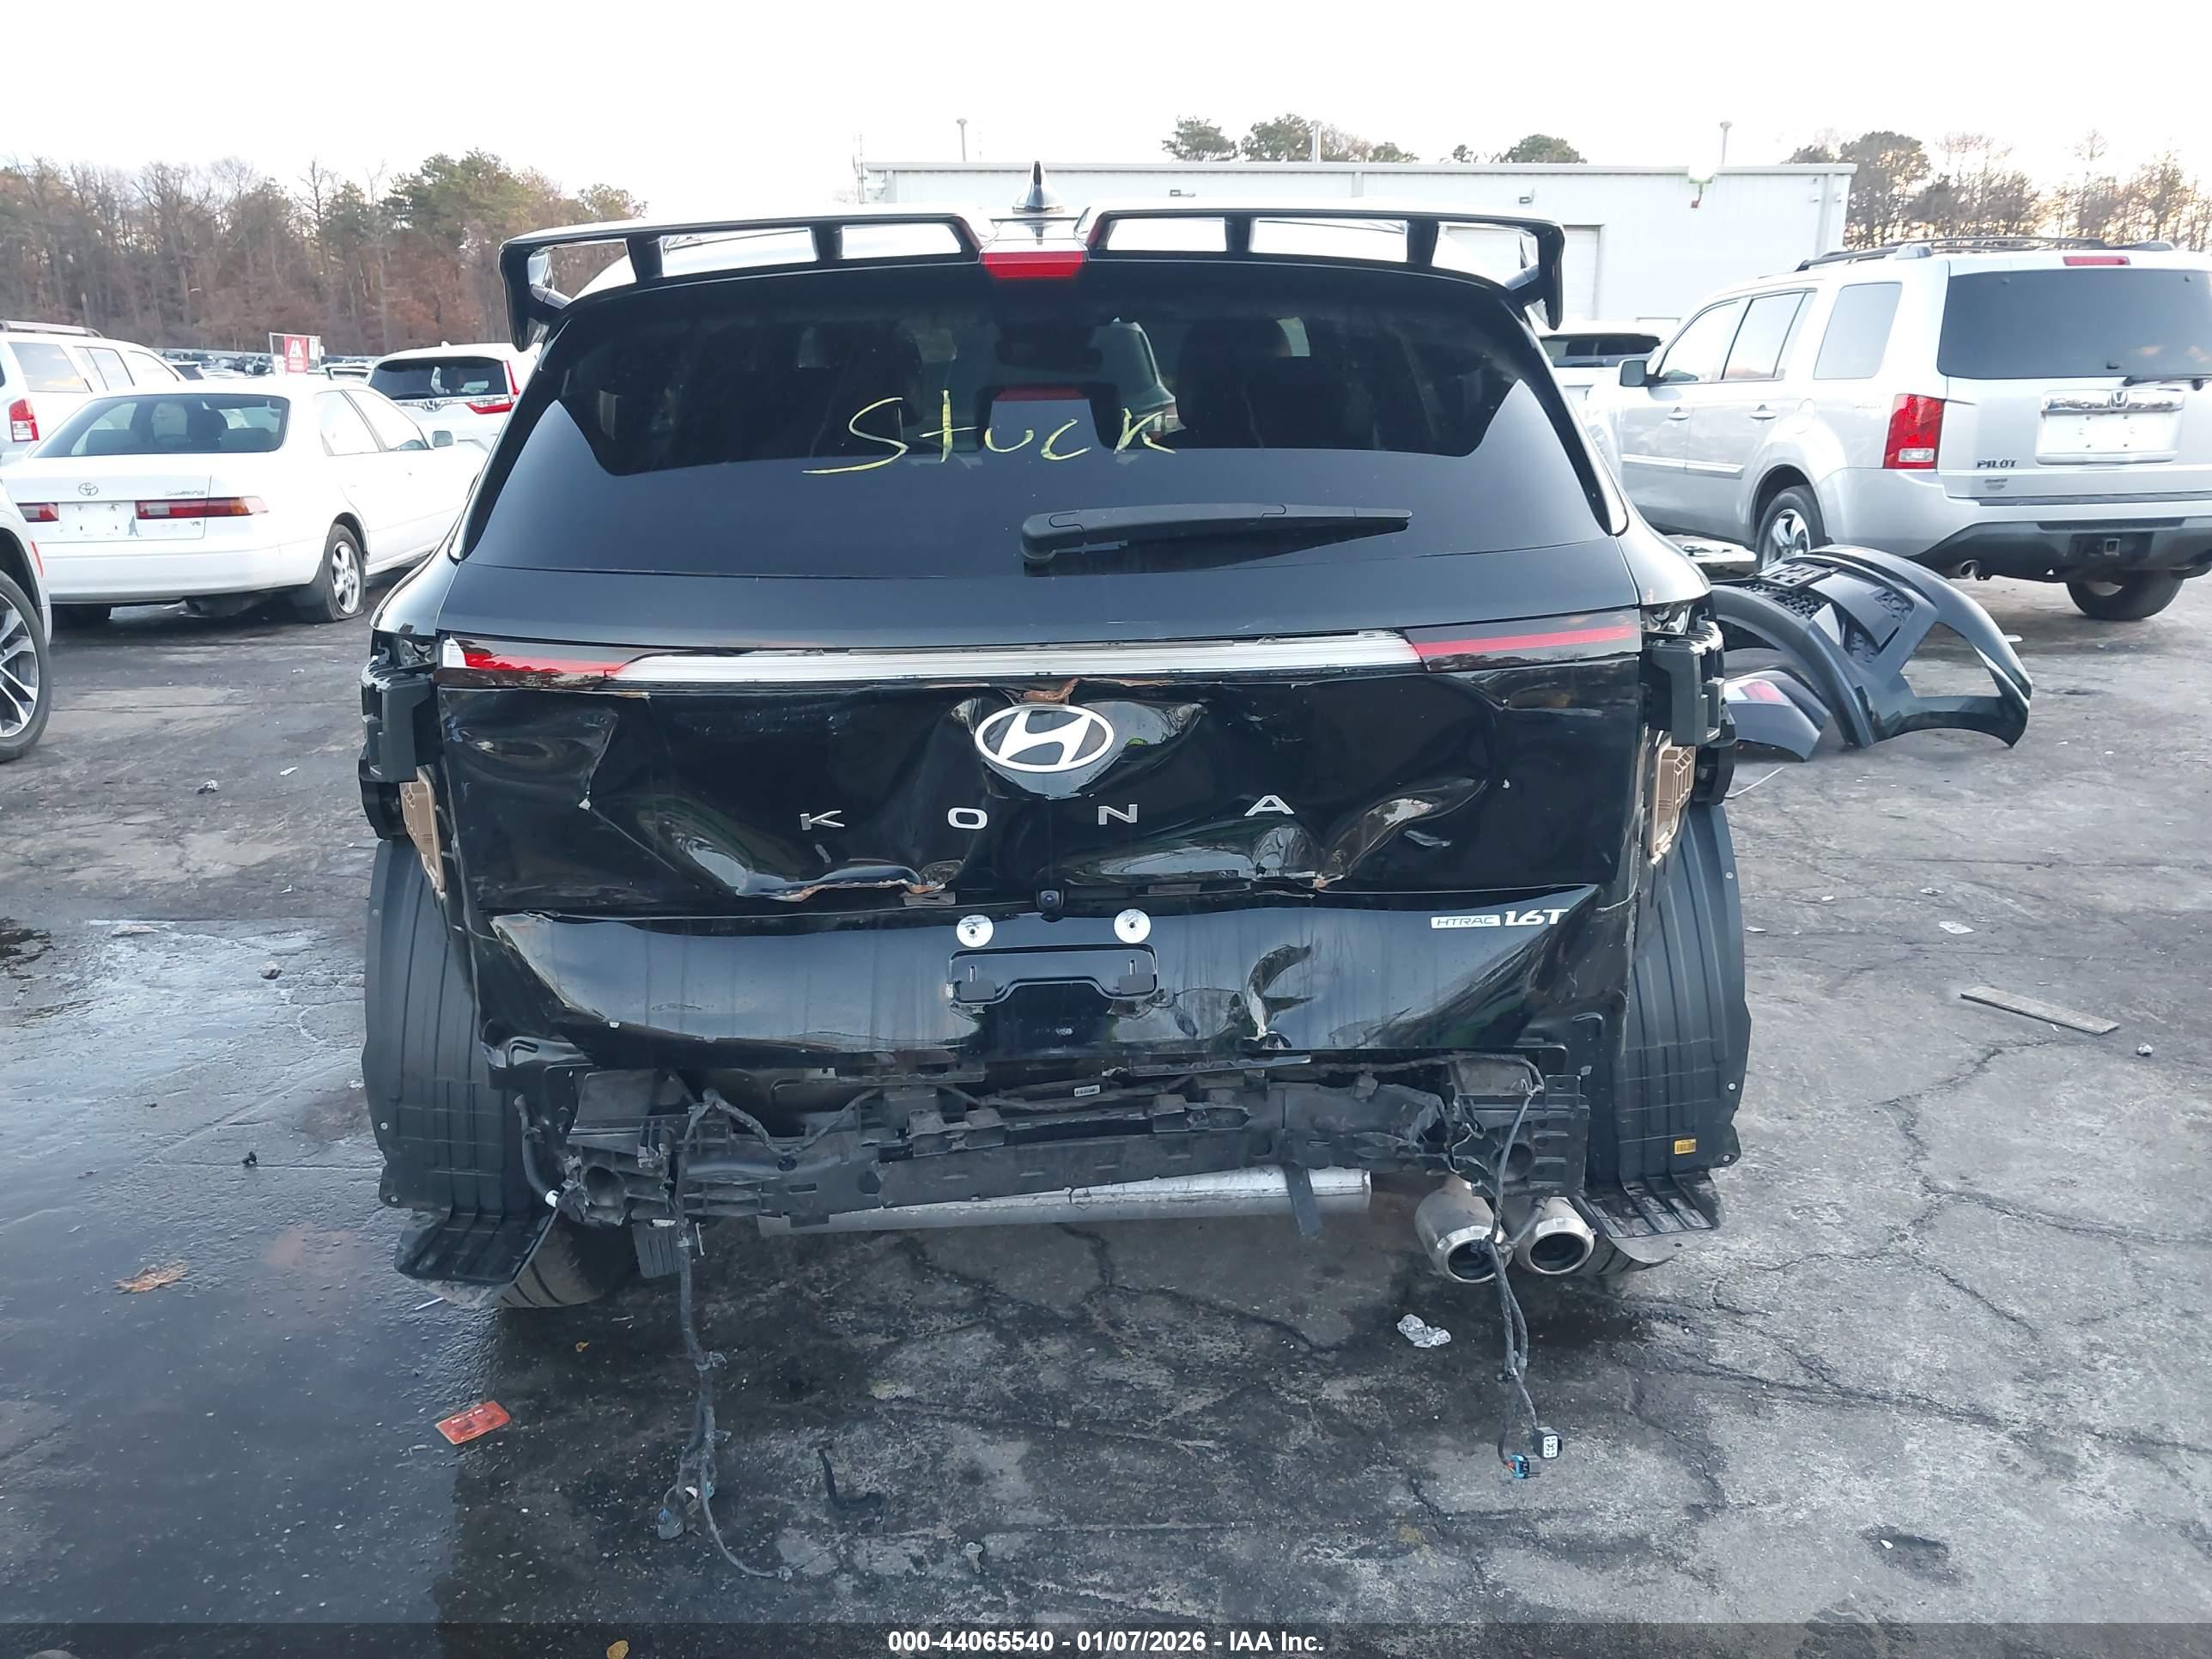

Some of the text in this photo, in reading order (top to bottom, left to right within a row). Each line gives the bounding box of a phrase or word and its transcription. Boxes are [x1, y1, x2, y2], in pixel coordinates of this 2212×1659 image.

[1976, 459, 2017, 469] PILOT
[799, 793, 1296, 831] KONA
[1434, 915, 1498, 927] HTRAC
